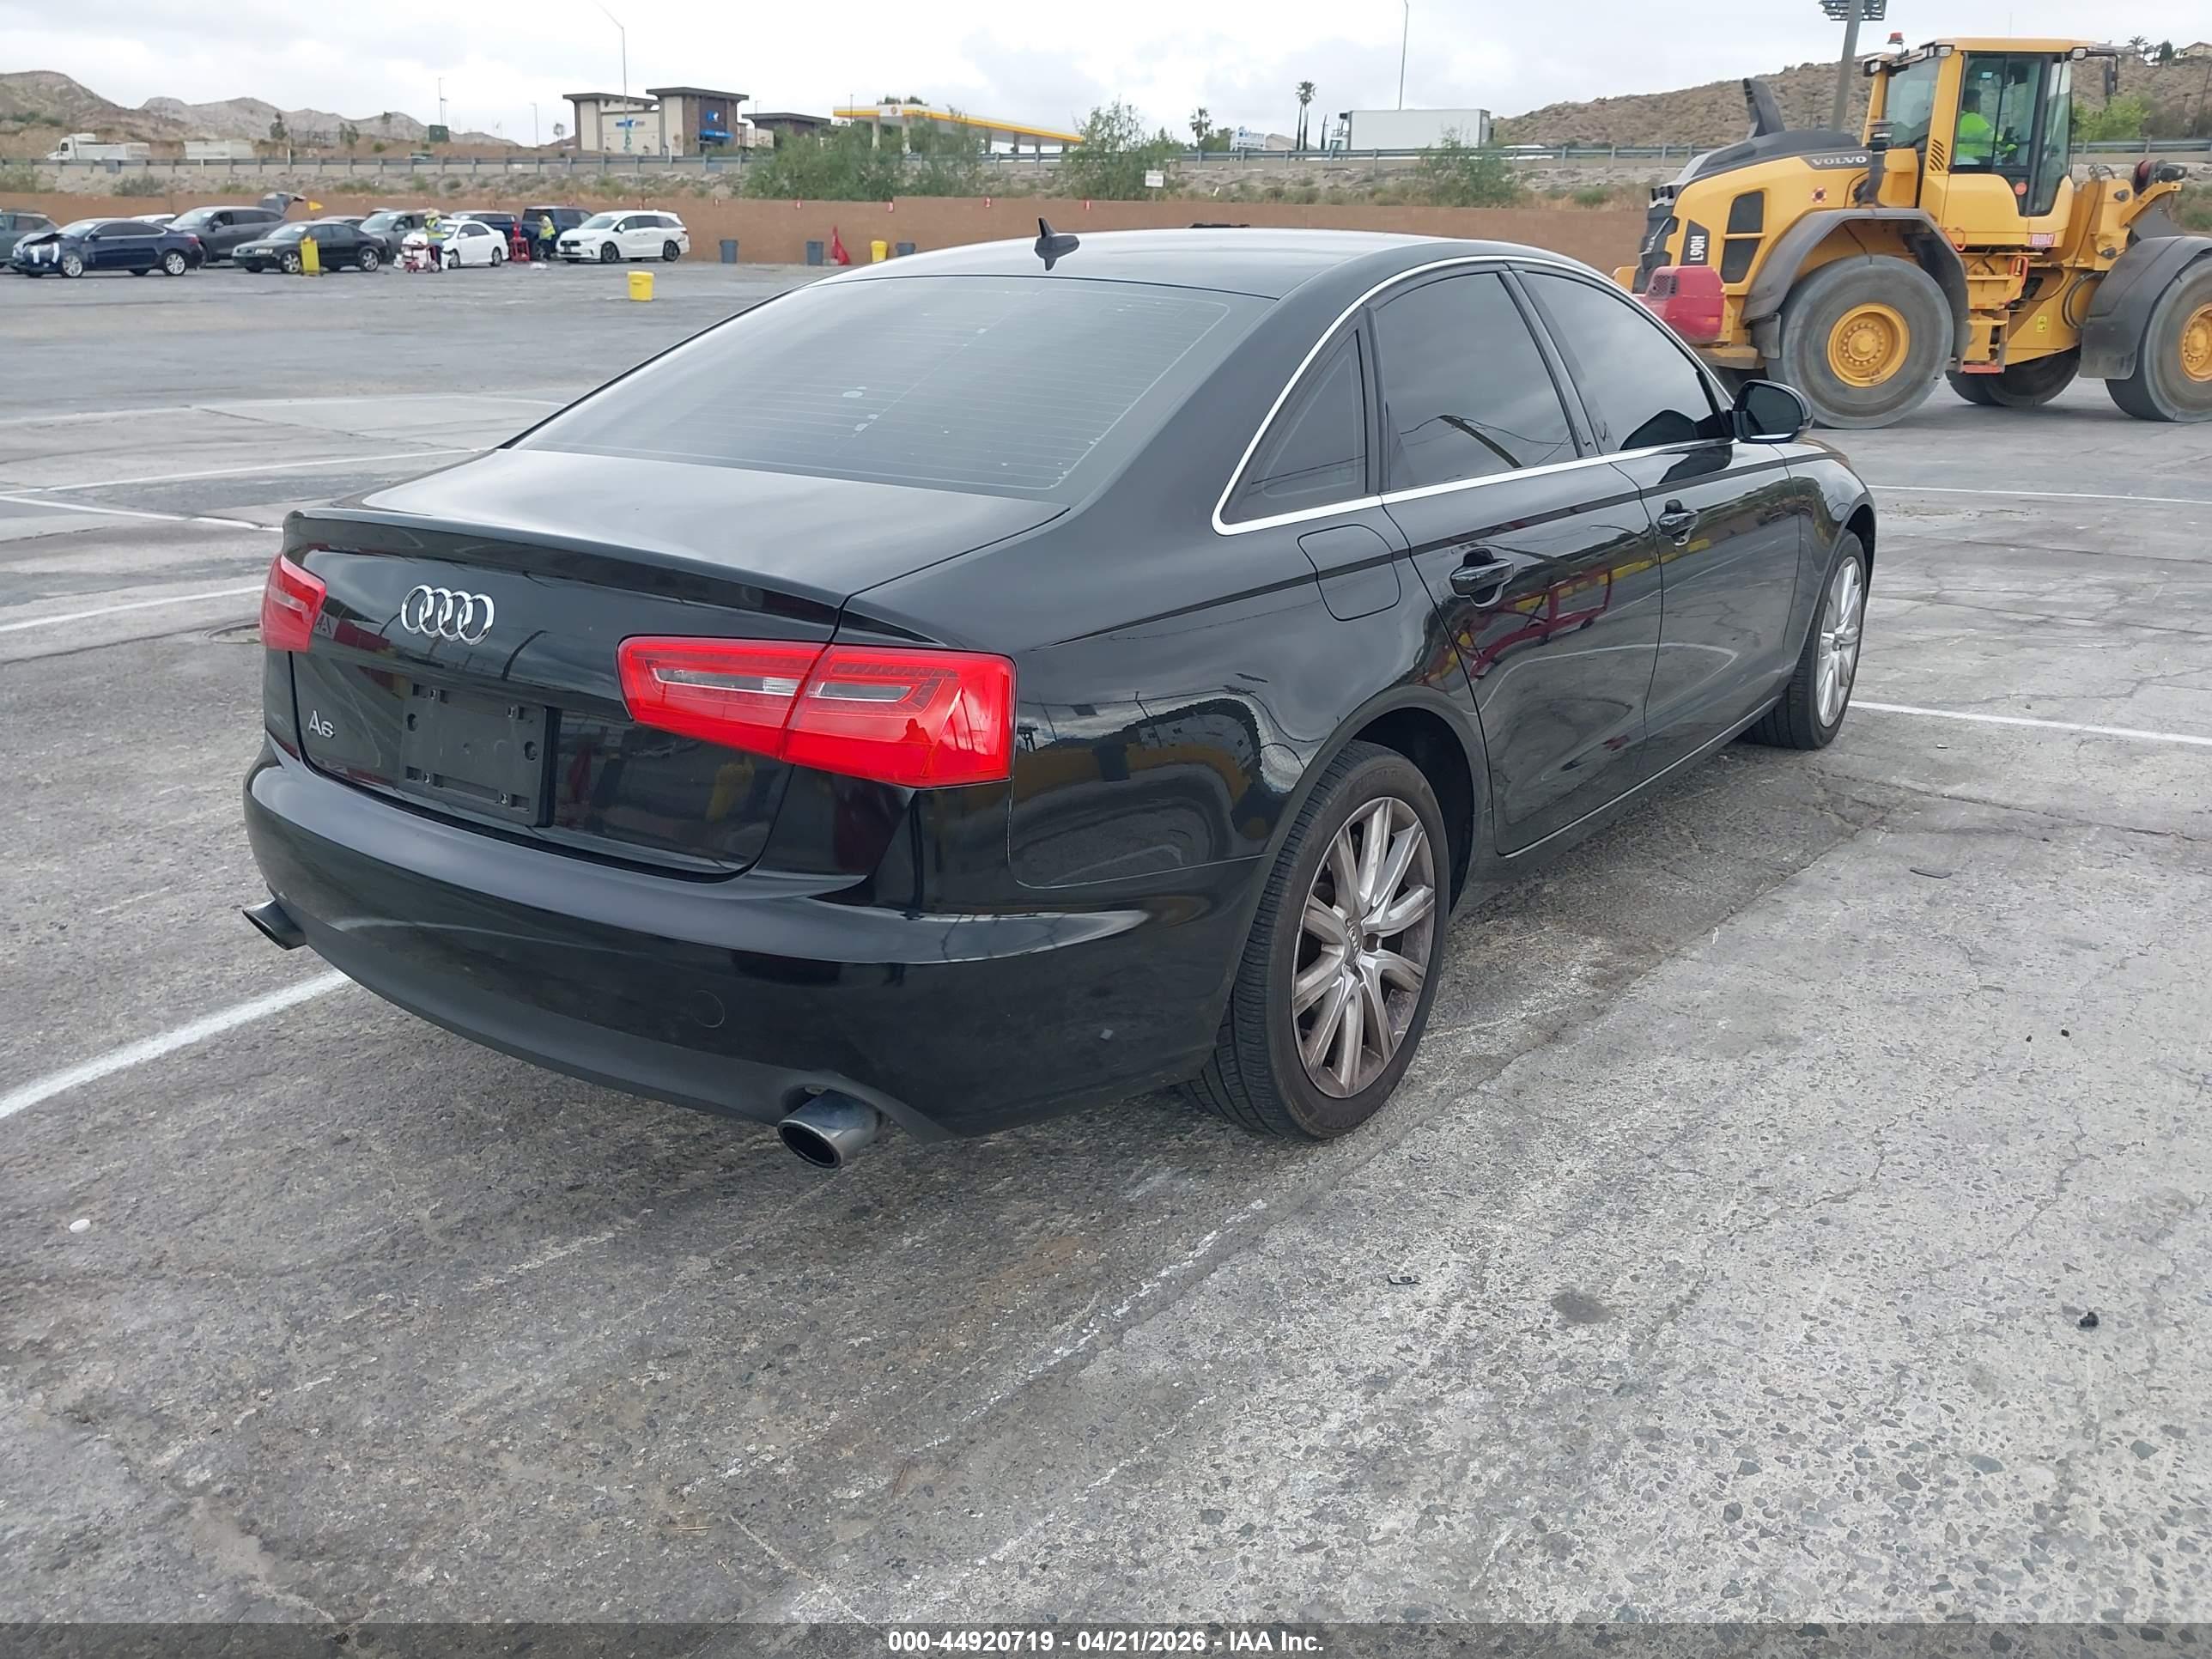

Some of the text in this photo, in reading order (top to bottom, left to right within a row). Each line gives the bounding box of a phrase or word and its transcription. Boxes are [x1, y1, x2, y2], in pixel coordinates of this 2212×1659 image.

[1811, 155, 1868, 166] VOLVO
[1689, 235, 1705, 261] L90H
[308, 710, 336, 739] A6
